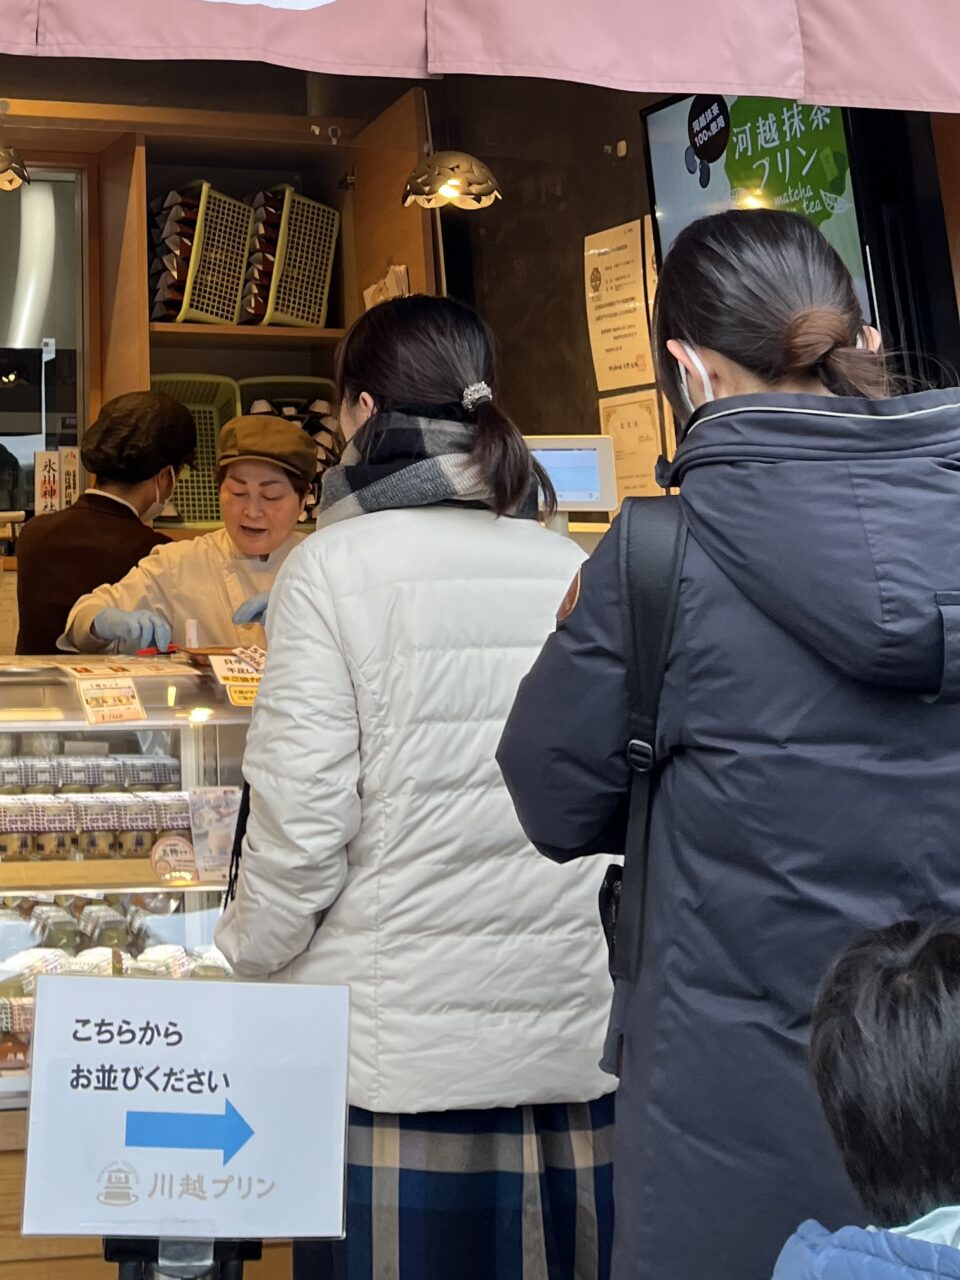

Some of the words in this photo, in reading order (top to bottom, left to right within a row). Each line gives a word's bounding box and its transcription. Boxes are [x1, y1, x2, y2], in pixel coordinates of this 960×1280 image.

[732, 103, 831, 160] 河越抹茶
[752, 146, 818, 191] プリン
[774, 182, 814, 207] matcha
[802, 197, 823, 214] tea
[42, 459, 58, 513] 氷川神社
[72, 1018, 183, 1047] こちらから
[70, 1064, 230, 1094] お並びください
[148, 1173, 276, 1200] 川越プリン
